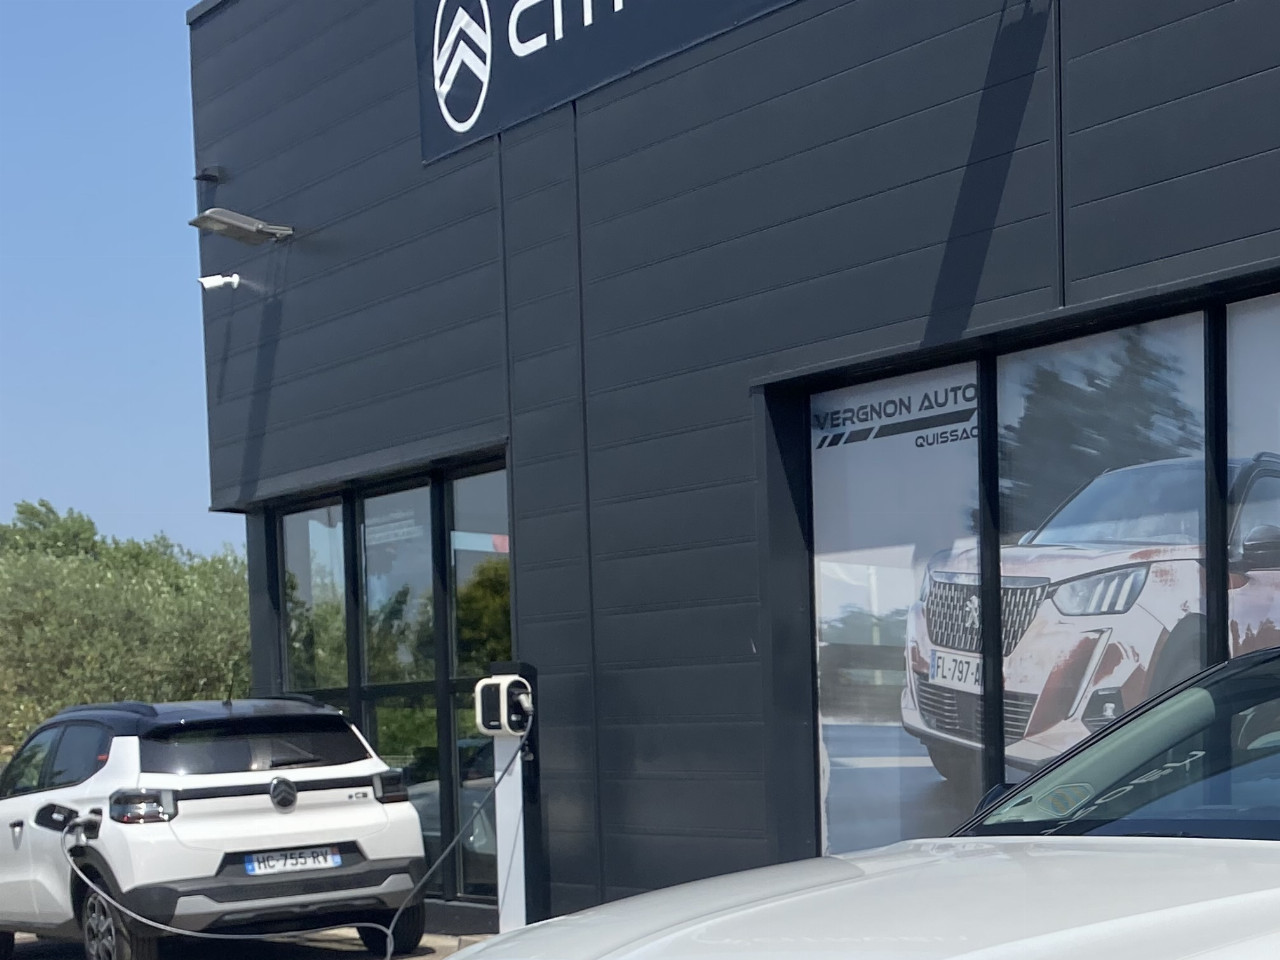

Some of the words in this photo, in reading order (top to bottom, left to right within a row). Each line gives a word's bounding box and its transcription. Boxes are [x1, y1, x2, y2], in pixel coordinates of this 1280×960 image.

[814, 396, 911, 430] VERGNON
[918, 383, 978, 412] AUTO
[256, 849, 329, 869] HC-755-RV
